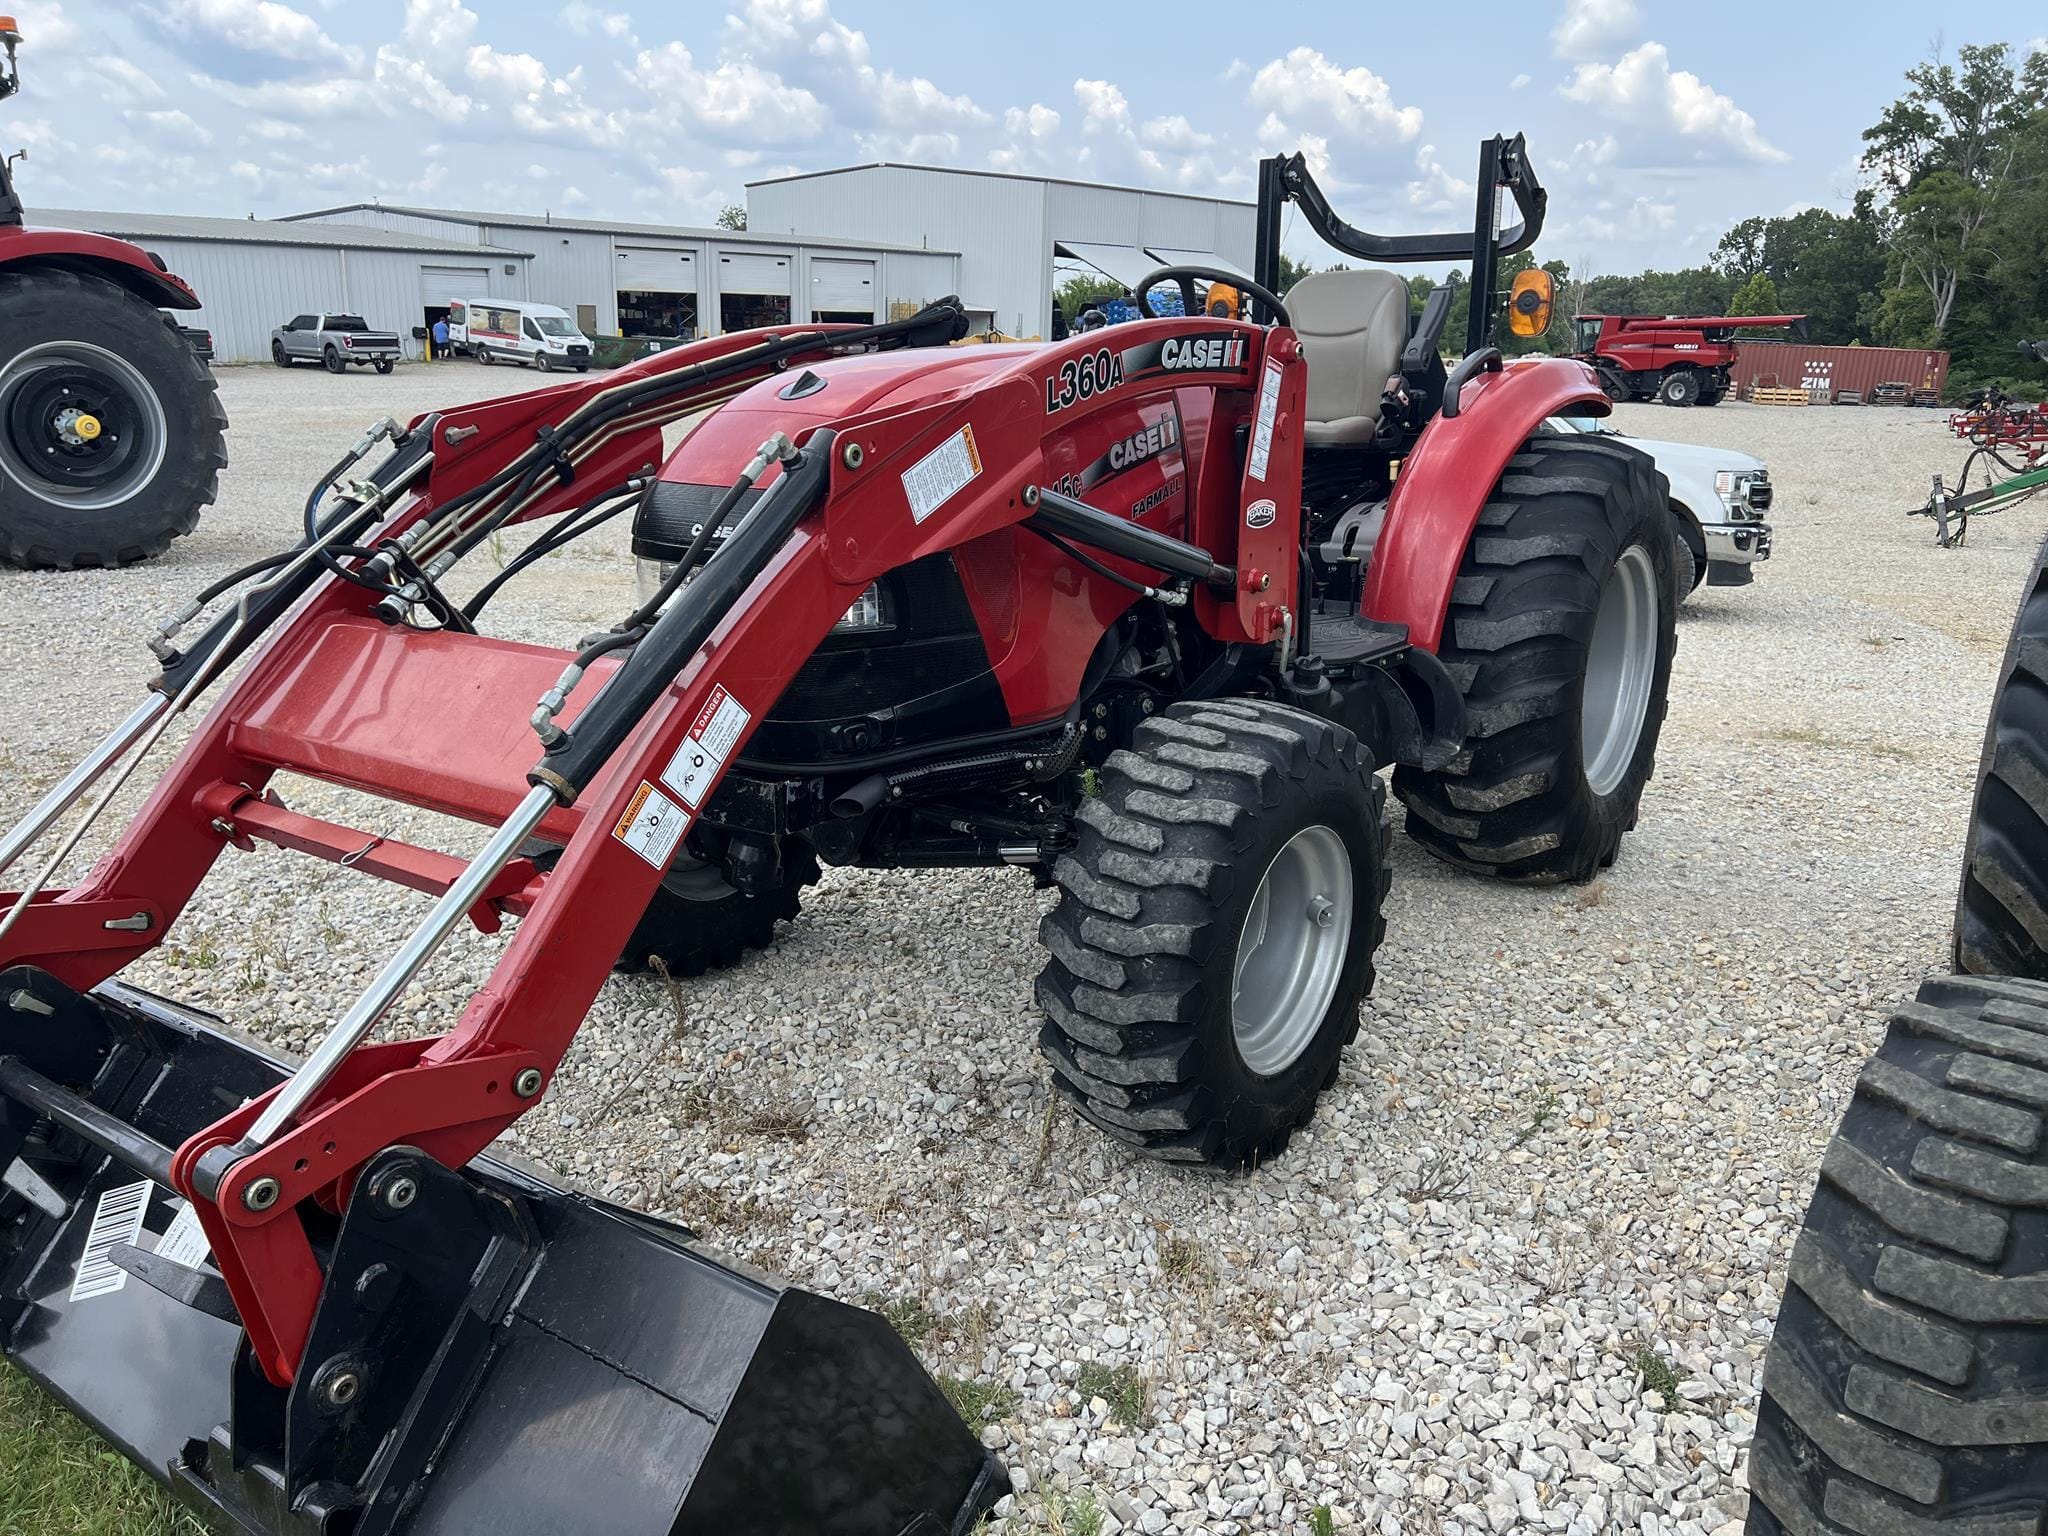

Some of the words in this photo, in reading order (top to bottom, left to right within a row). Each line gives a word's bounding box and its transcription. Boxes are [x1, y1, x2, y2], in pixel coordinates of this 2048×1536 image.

[1046, 347, 1124, 415] L360A
[1800, 376, 1831, 389] ZIM
[1132, 477, 1182, 520] FARMALL
[1249, 504, 1273, 521] BAKER
[691, 523, 735, 538] CSE
[699, 692, 723, 727] DANGER
[626, 789, 648, 824] WARNING
